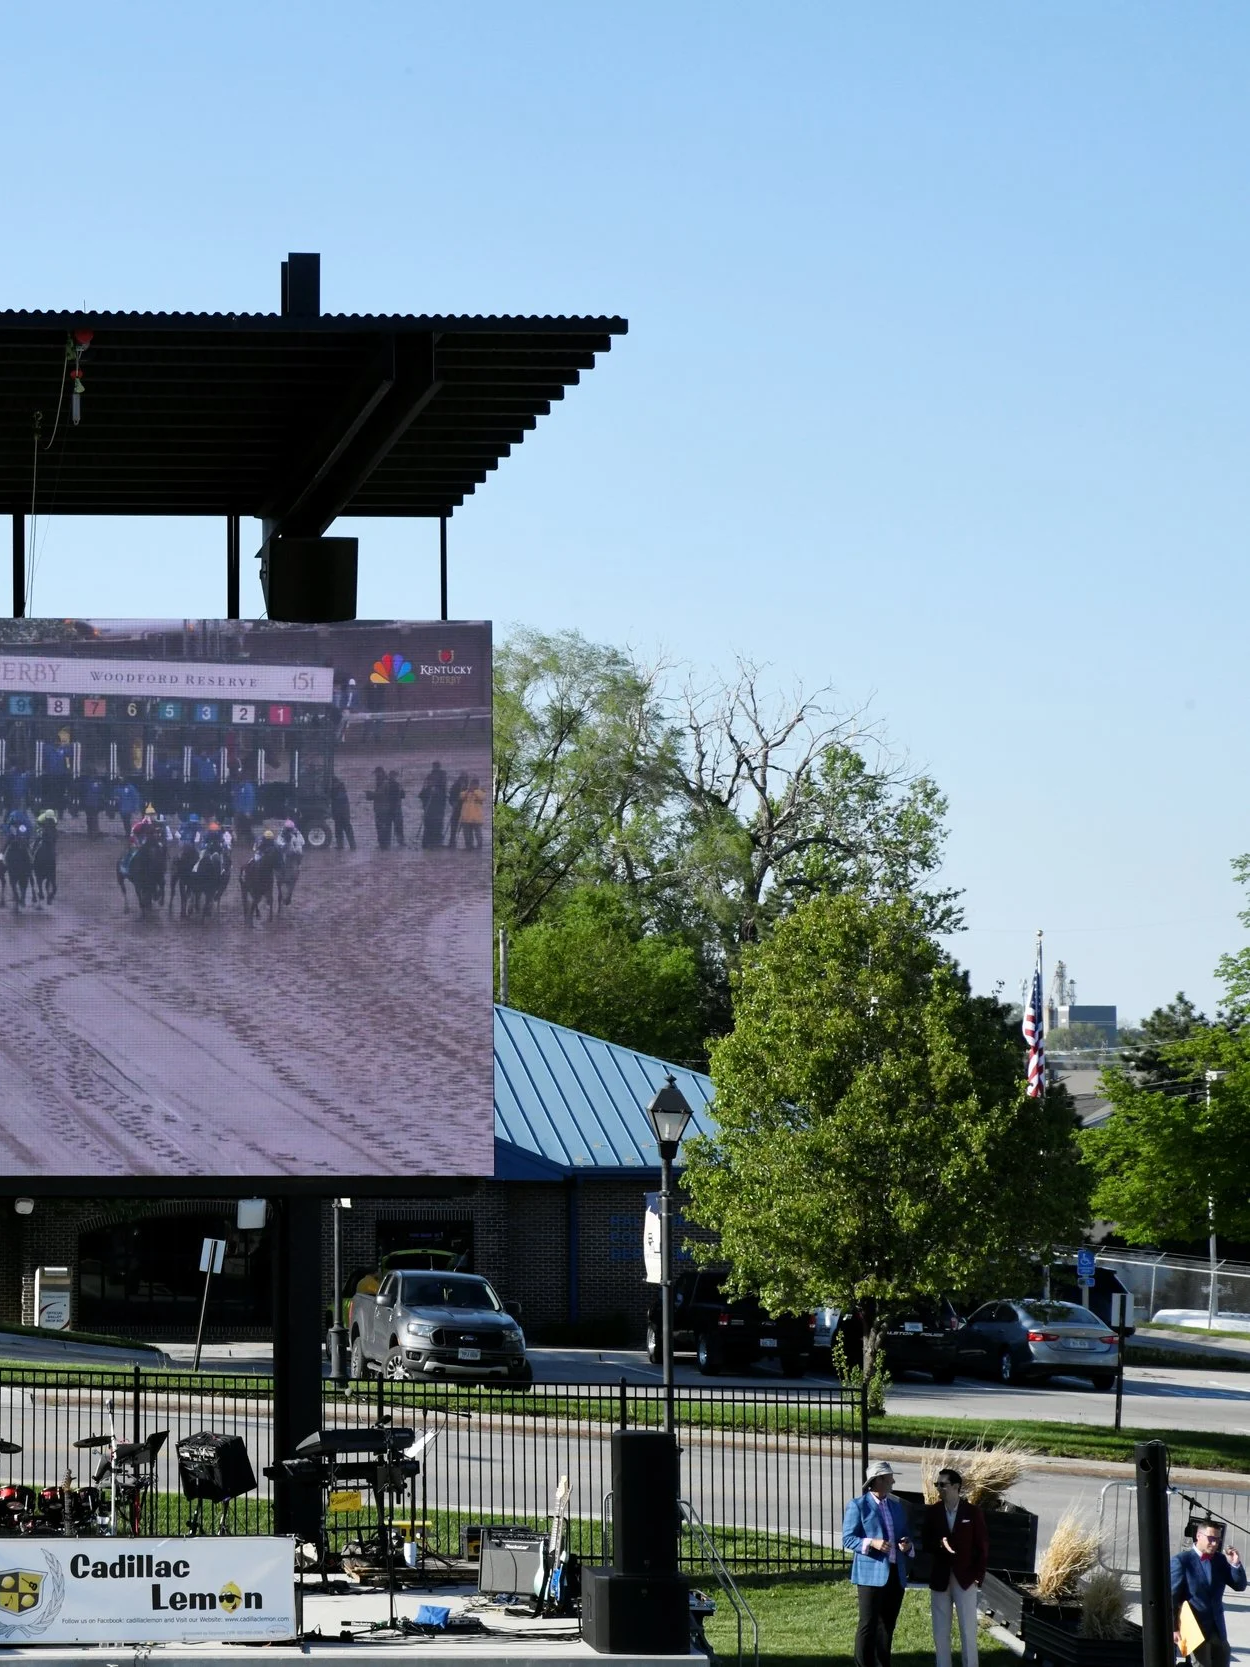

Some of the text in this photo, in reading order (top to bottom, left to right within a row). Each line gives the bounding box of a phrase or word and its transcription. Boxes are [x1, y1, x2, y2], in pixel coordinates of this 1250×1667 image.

[419, 664, 473, 676] KENTUCKY
[90, 671, 260, 688] WOODFORD RESERVE
[431, 675, 462, 685] DERBY
[53, 699, 64, 714] 8
[90, 701, 100, 715] 7
[127, 703, 138, 717] 6
[165, 704, 175, 718] 5
[201, 706, 212, 720] 3
[238, 707, 249, 721] 2
[277, 708, 285, 722] 1
[69, 1553, 191, 1579] Cadillac
